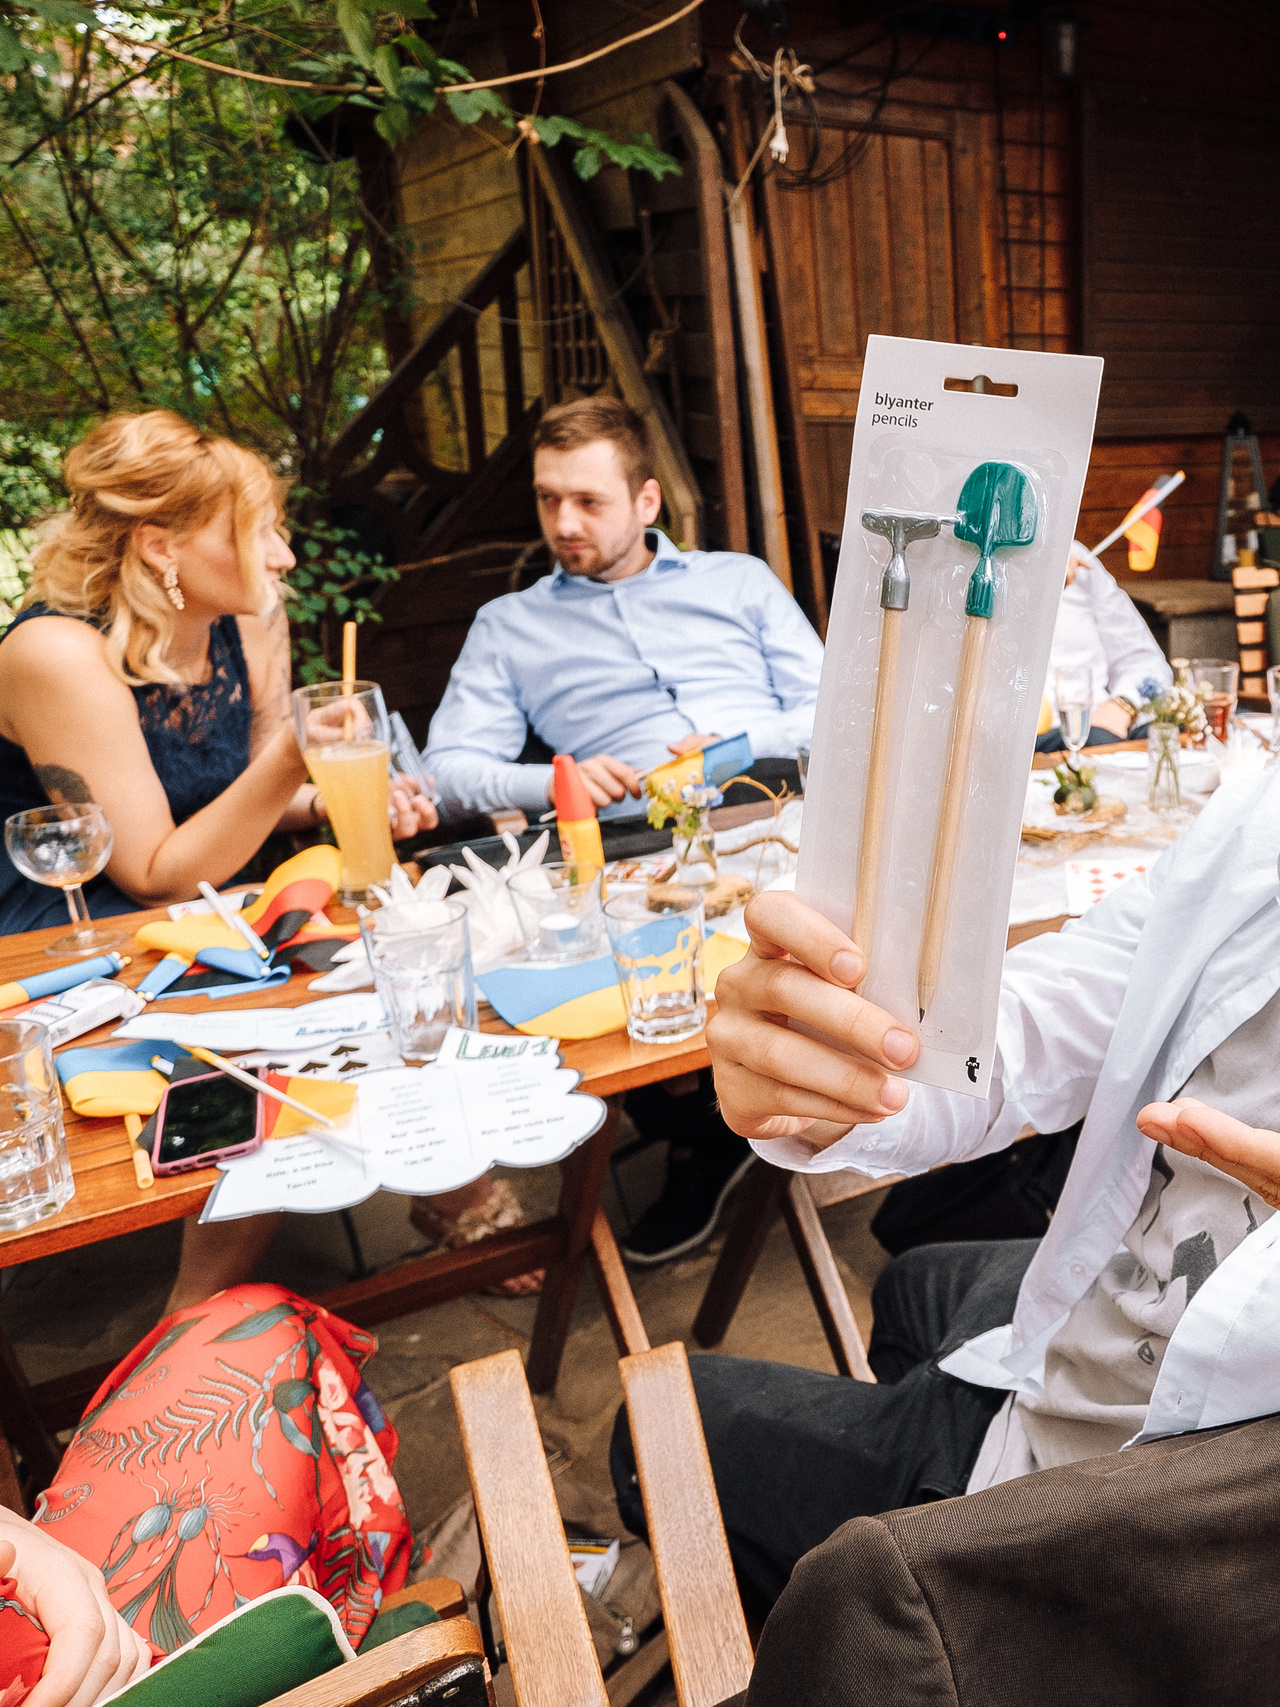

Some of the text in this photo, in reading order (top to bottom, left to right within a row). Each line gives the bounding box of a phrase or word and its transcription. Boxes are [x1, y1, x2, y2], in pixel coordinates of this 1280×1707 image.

[874, 392, 934, 411] blyanter
[871, 413, 918, 428] pencils
[532, 1037, 552, 1057] 1
